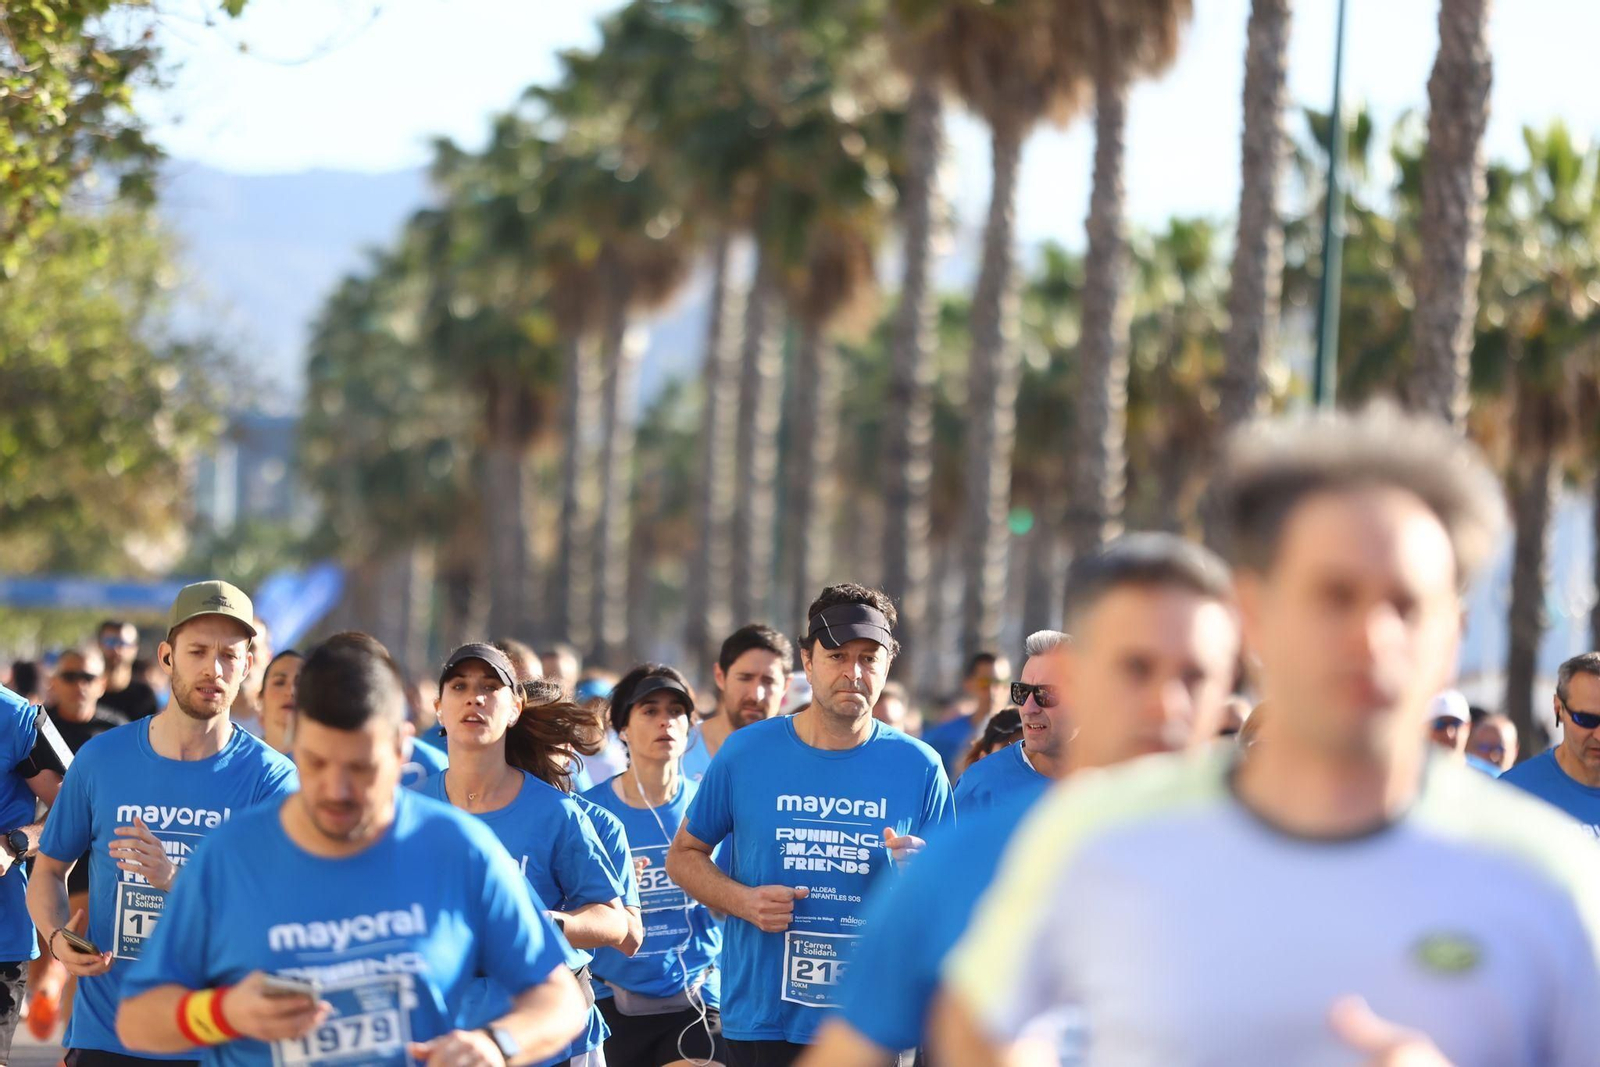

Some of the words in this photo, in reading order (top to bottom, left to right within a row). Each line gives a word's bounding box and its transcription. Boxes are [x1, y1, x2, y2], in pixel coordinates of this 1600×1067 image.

[776, 794, 887, 819] mayoral
[116, 804, 231, 830] mayoral
[776, 828, 879, 848] RUNNING
[785, 842, 871, 861] MAKES
[783, 857, 871, 875] FRIENDS
[135, 892, 164, 902] Carrera
[811, 886, 837, 894] ALDEAS
[135, 900, 166, 909] Solidari
[810, 893, 847, 902] INFANTILES
[848, 895, 861, 903] SOS
[268, 902, 426, 953] mayoral
[803, 941, 832, 950] Carrera
[803, 947, 837, 957] Solidaria
